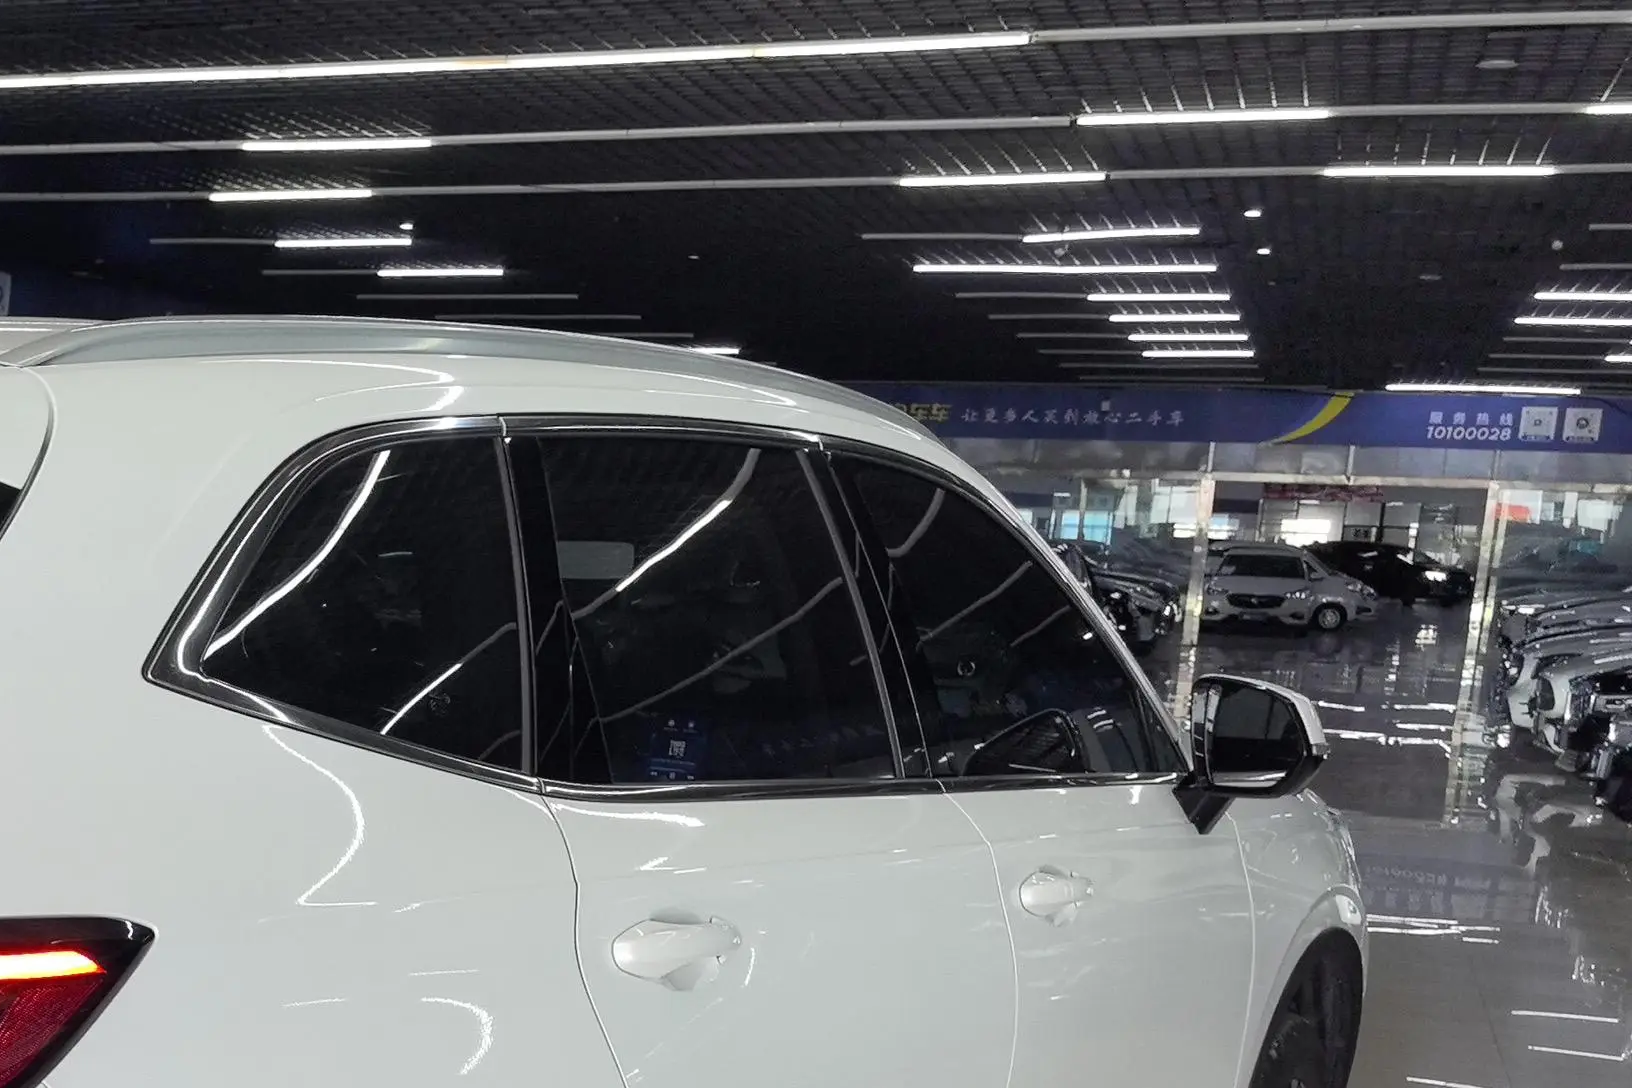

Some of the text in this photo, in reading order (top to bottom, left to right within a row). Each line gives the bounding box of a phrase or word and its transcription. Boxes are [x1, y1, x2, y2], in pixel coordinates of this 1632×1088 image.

[961, 408, 1185, 426] 让更多人买到放心二手车
[1426, 426, 1512, 441] 10100028
